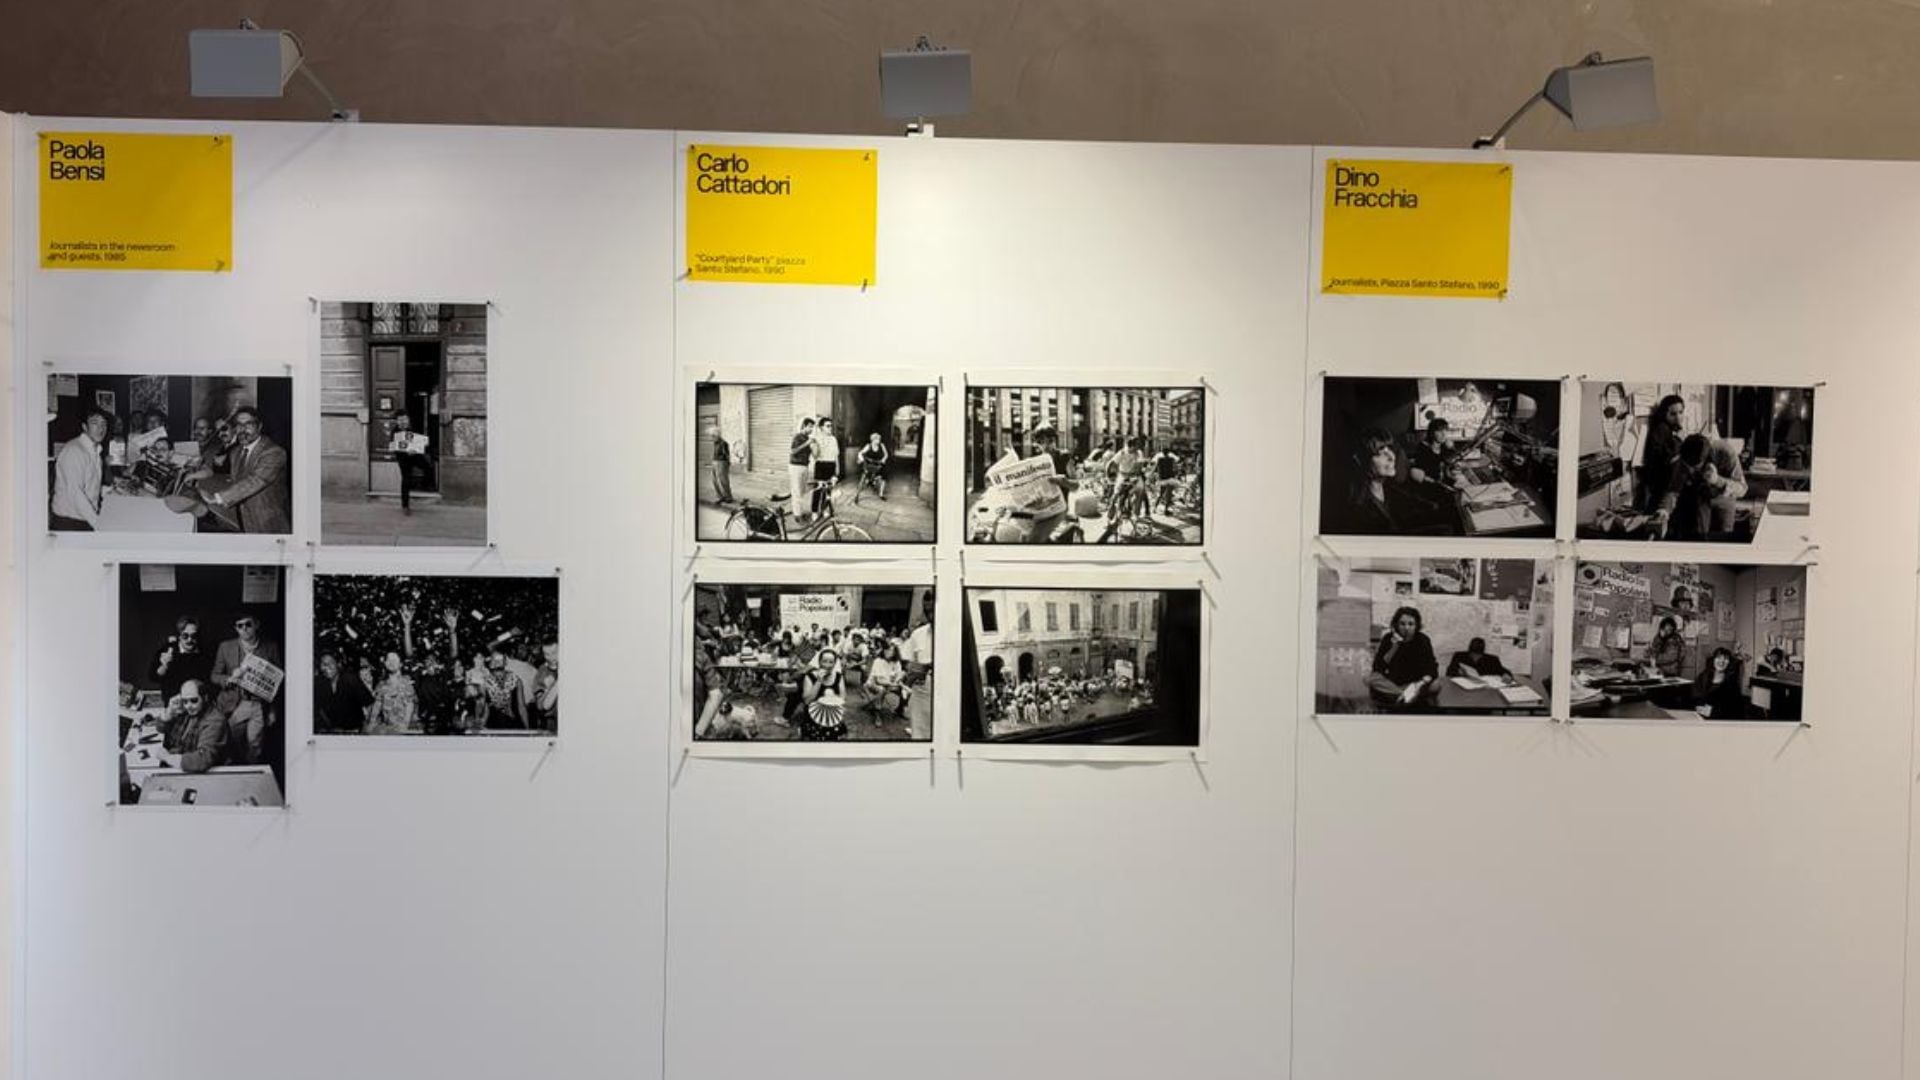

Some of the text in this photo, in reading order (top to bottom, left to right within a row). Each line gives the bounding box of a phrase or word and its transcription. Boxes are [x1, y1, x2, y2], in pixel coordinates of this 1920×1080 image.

[50, 140, 105, 160] Paola
[50, 161, 105, 181] Bensi
[697, 153, 749, 173] Carlo
[697, 174, 790, 195] Cattadori
[1335, 167, 1379, 187] Dino
[1335, 188, 1418, 208] Fracchia
[49, 252, 67, 261] and
[50, 241, 175, 252] Journalists in the newsroom
[1381, 279, 1410, 288] Piazza
